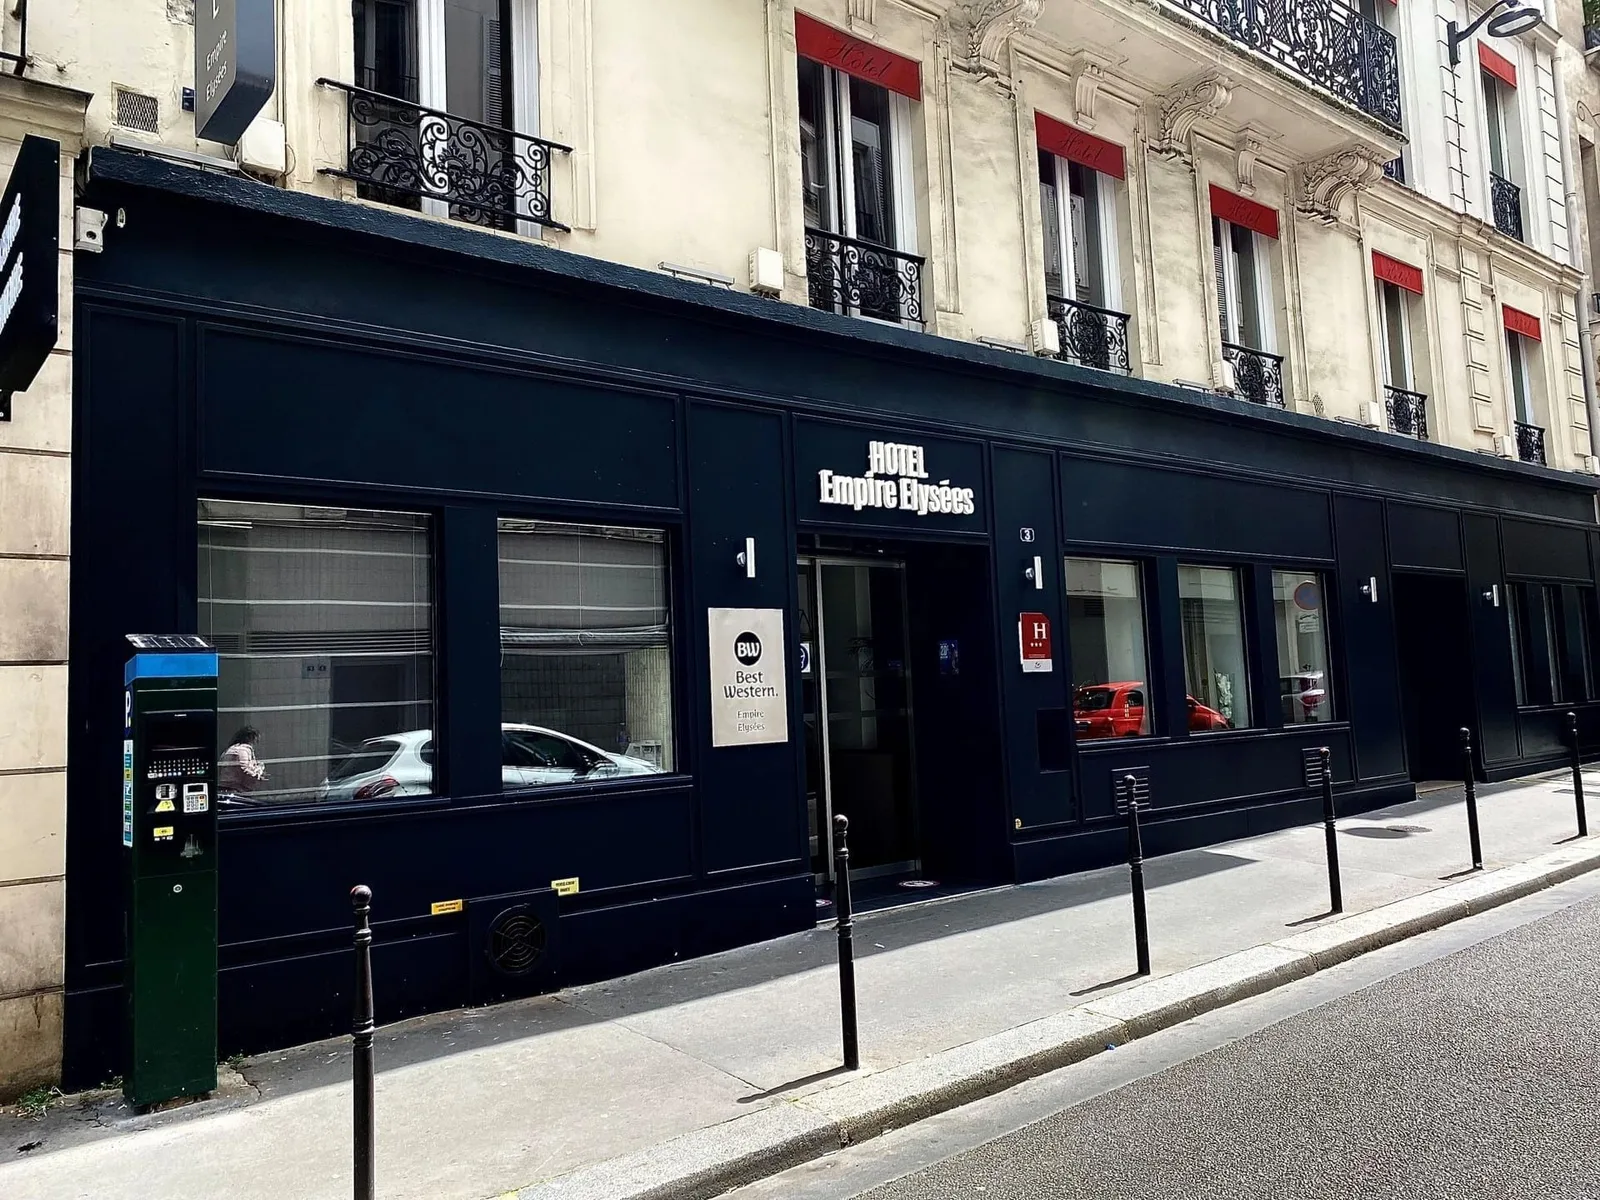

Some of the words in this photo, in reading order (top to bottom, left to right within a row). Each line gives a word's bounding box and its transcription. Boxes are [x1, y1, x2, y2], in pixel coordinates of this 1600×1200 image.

[206, 30, 227, 71] Empire
[865, 440, 929, 479] HOTEL
[818, 469, 898, 511] Empire
[899, 477, 975, 515] Elysées
[1024, 529, 1031, 540] 3
[1033, 622, 1047, 640] H
[737, 642, 760, 657] BW
[736, 670, 764, 684] Best
[723, 685, 779, 698] Western.
[737, 709, 764, 719] Empire
[737, 723, 766, 733] Elysées
